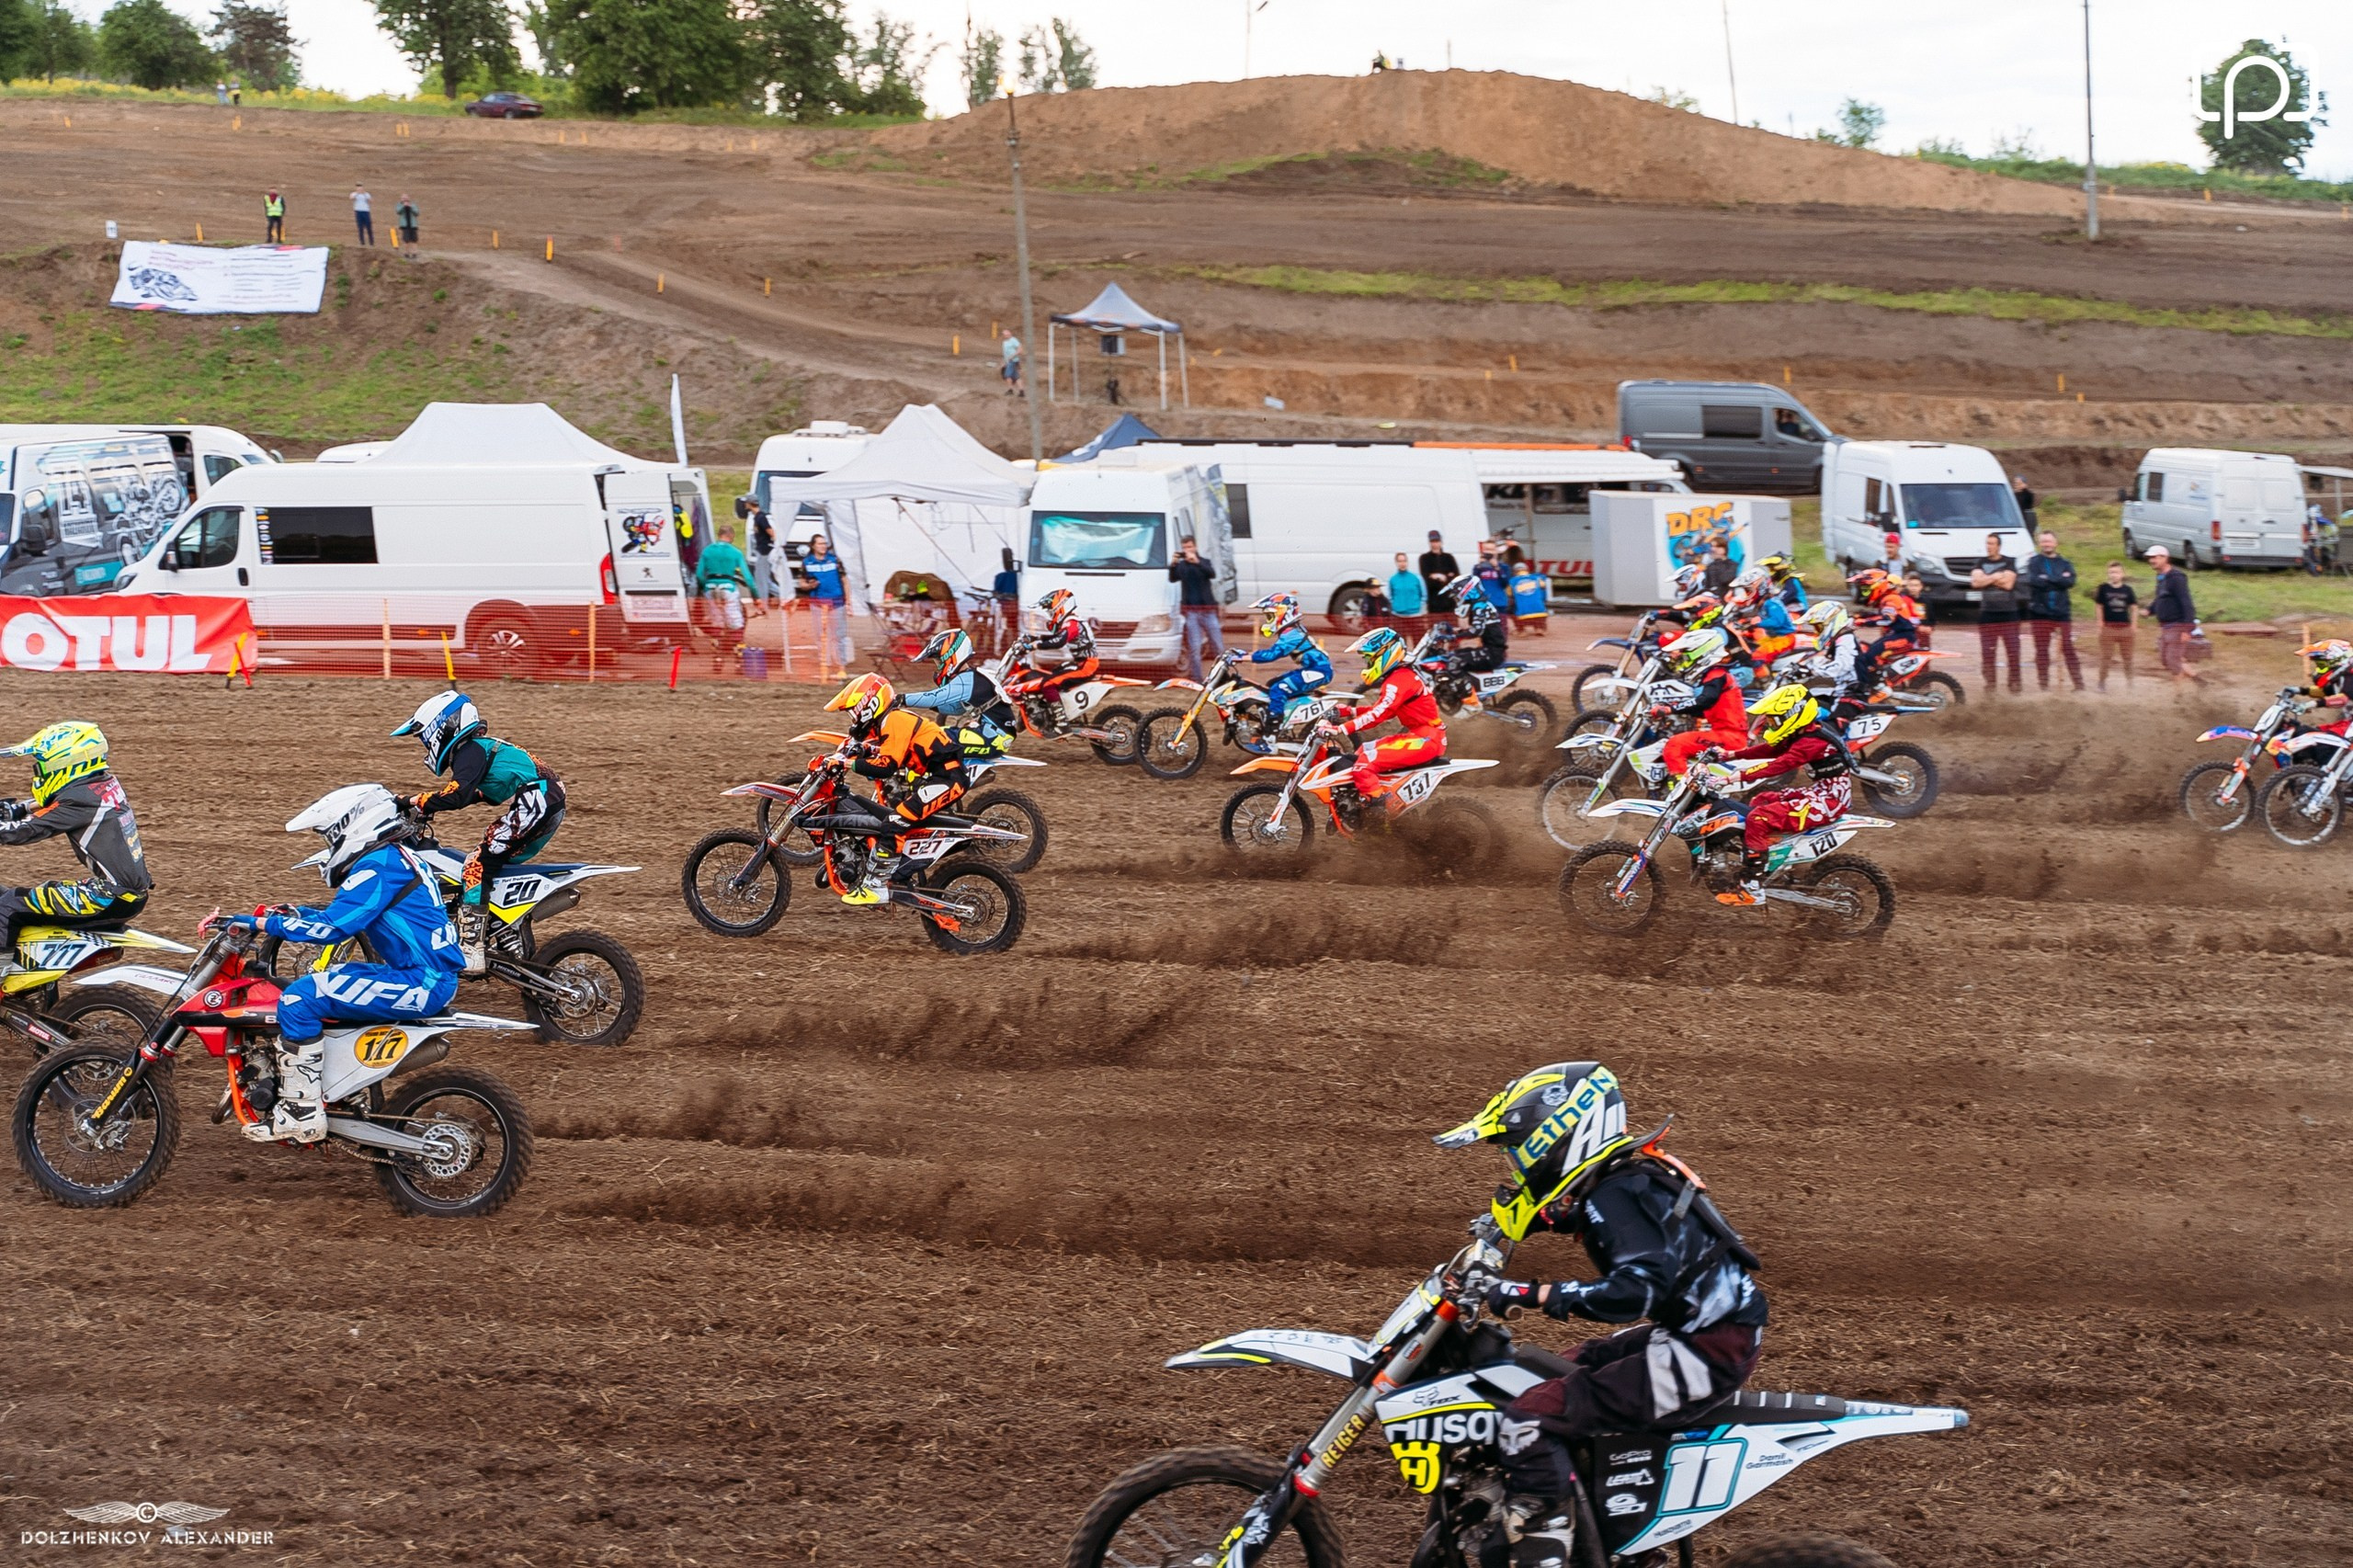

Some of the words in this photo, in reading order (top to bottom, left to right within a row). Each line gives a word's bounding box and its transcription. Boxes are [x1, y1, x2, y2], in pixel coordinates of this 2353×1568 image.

[854, 687, 876, 715] 100%
[1074, 690, 1089, 710] 9
[1300, 701, 1324, 721] 761
[422, 711, 447, 743] 100%
[1858, 718, 1881, 735] 75
[1700, 814, 1739, 835] KTM
[908, 839, 943, 856] 227
[1809, 831, 1838, 858] 120
[503, 879, 542, 907] 20
[39, 943, 87, 970] 777
[28, 1024, 51, 1041] MOTUL
[363, 1036, 404, 1062] 117
[1429, 1394, 1461, 1406] FOX
[1321, 1413, 1366, 1469] REIGER
[1661, 1440, 1745, 1514] 11
